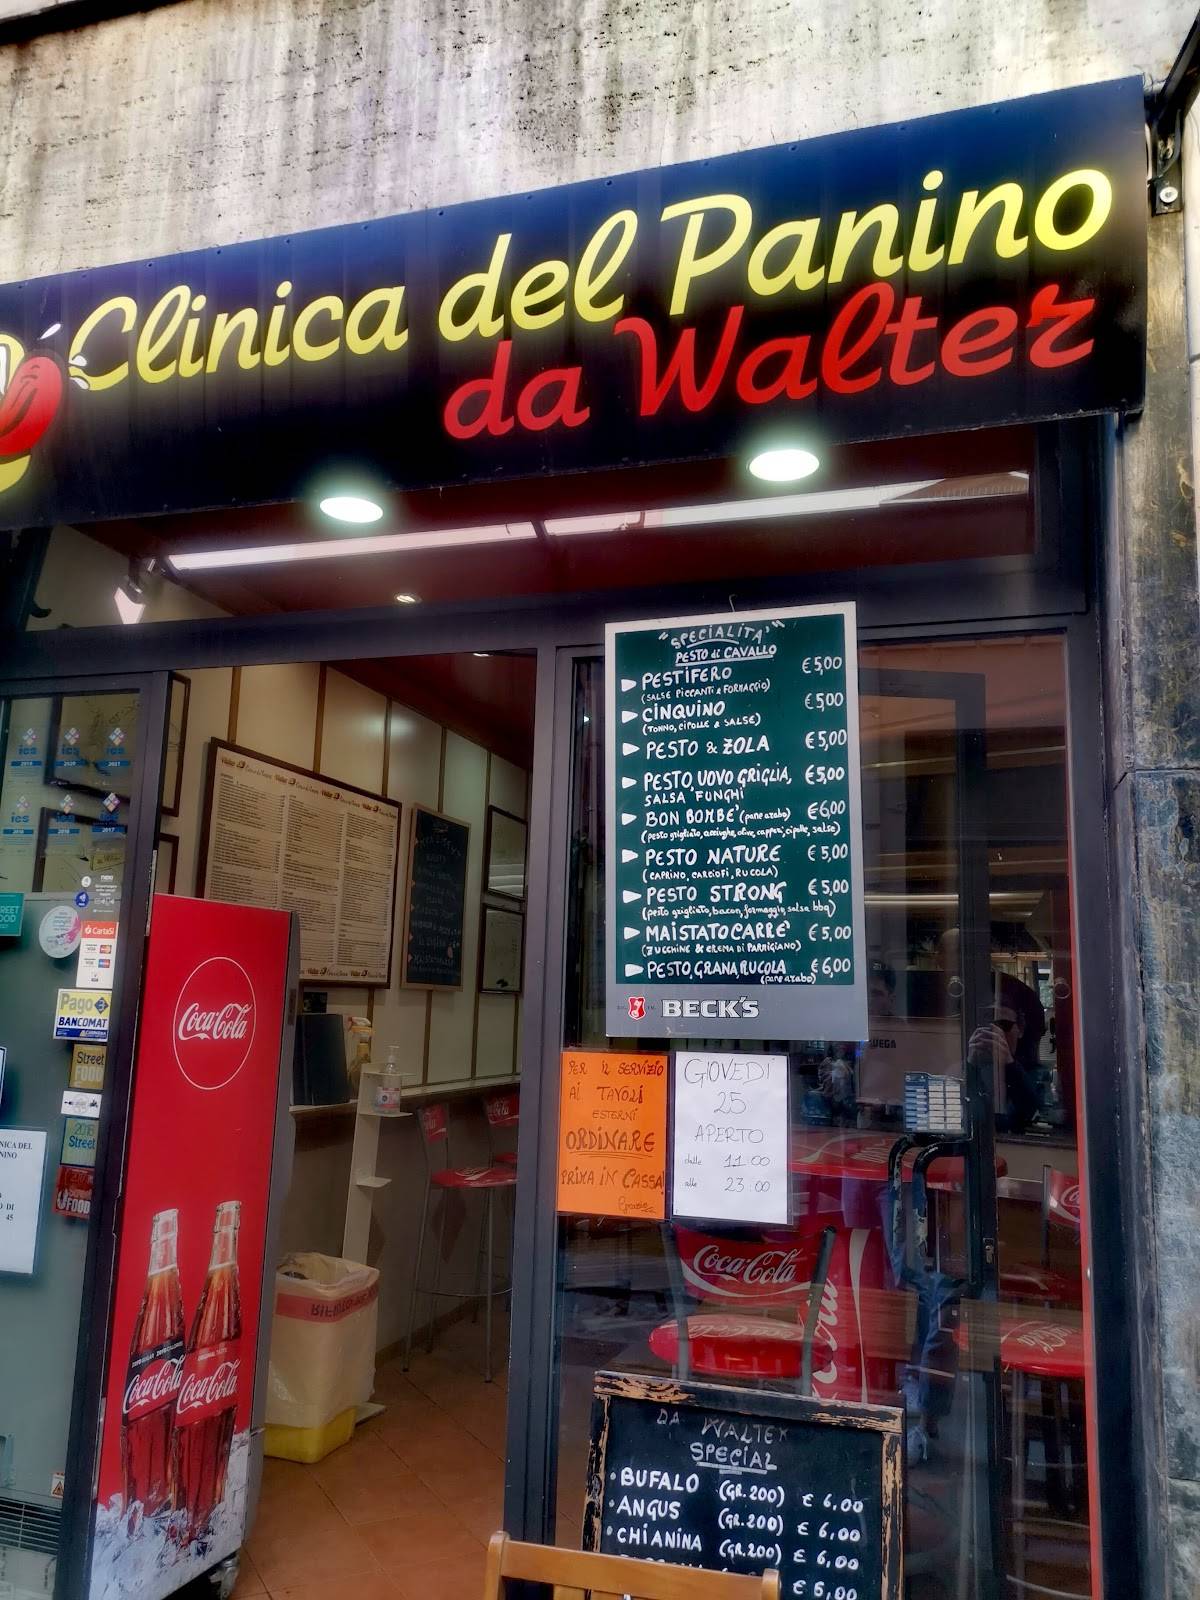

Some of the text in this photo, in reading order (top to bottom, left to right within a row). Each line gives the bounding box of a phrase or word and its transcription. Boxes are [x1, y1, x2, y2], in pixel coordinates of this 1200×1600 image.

[68, 169, 1113, 391] Clinica del Panino
[443, 282, 1097, 440] da Walter
[675, 648, 708, 664] PESTO
[724, 644, 777, 659] CAVALLO
[724, 712, 761, 727] SALSE)
[646, 739, 699, 760] PESTO
[706, 741, 718, 754] &
[722, 735, 770, 755] ZOLA
[697, 769, 734, 787] UOVO
[643, 791, 686, 807] SALSA
[645, 811, 680, 827] BON
[812, 820, 841, 836] salse)
[645, 848, 698, 866] PESTO
[706, 844, 782, 865] NATURE
[646, 886, 697, 903] PESTO
[710, 881, 787, 903] STRONG
[787, 902, 810, 913] salsa
[812, 899, 837, 918] bbq)
[60, 993, 93, 1014] Pago
[661, 995, 760, 1018] BECK'S
[58, 1016, 107, 1028] BANCOMAT
[178, 1002, 253, 1041] Coca-Cola
[77, 1051, 104, 1066] Street
[568, 1060, 588, 1075] PER
[713, 1091, 747, 1115] 25
[68, 1135, 96, 1150] Street
[694, 1123, 763, 1144] APERTO
[18, 1141, 33, 1150] DEL
[6, 1203, 14, 1211] DI
[67, 1198, 91, 1214] FOOD
[6, 1213, 14, 1221] 45
[693, 1244, 803, 1285] Coca-Cola
[176, 1359, 240, 1415] Coca-Cola
[657, 1408, 680, 1425] DA
[689, 1441, 777, 1471] SPECIAL
[620, 1466, 700, 1493] BUFALO
[616, 1495, 681, 1521] ANGUS
